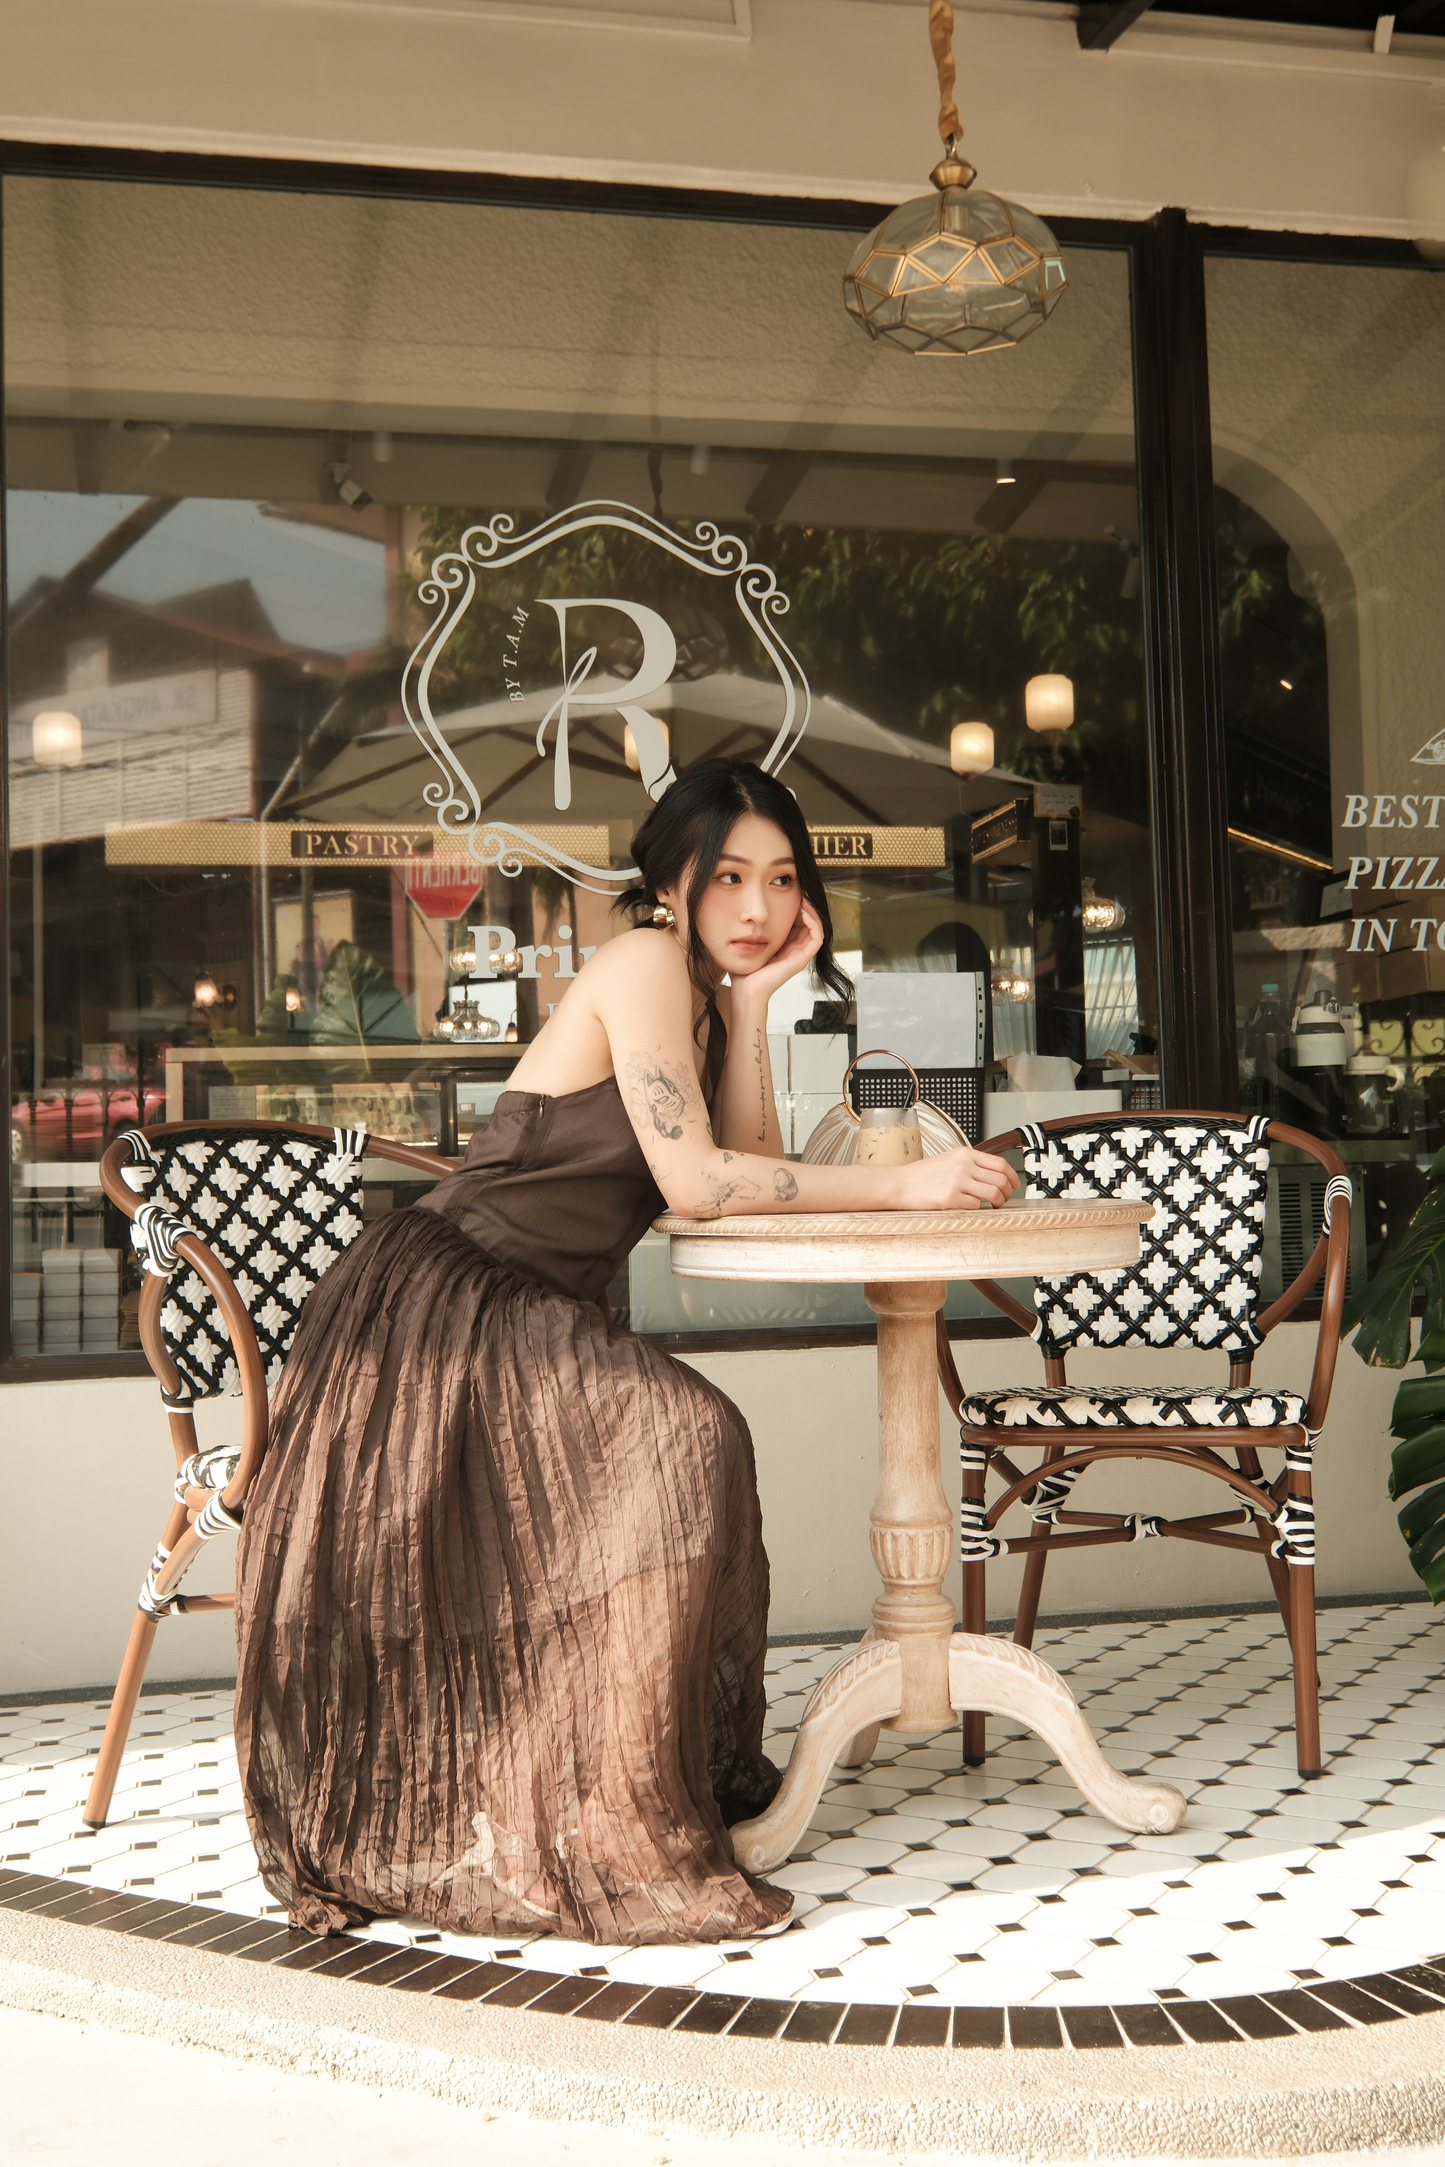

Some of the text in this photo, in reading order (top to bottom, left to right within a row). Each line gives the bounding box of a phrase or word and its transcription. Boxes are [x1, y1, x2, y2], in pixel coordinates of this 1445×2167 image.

[502, 605, 530, 703] BY T.A.M
[1341, 794, 1445, 829] BEST
[305, 834, 420, 856] PASTRY
[1344, 856, 1445, 890] PIZZ
[1346, 918, 1398, 953] IN
